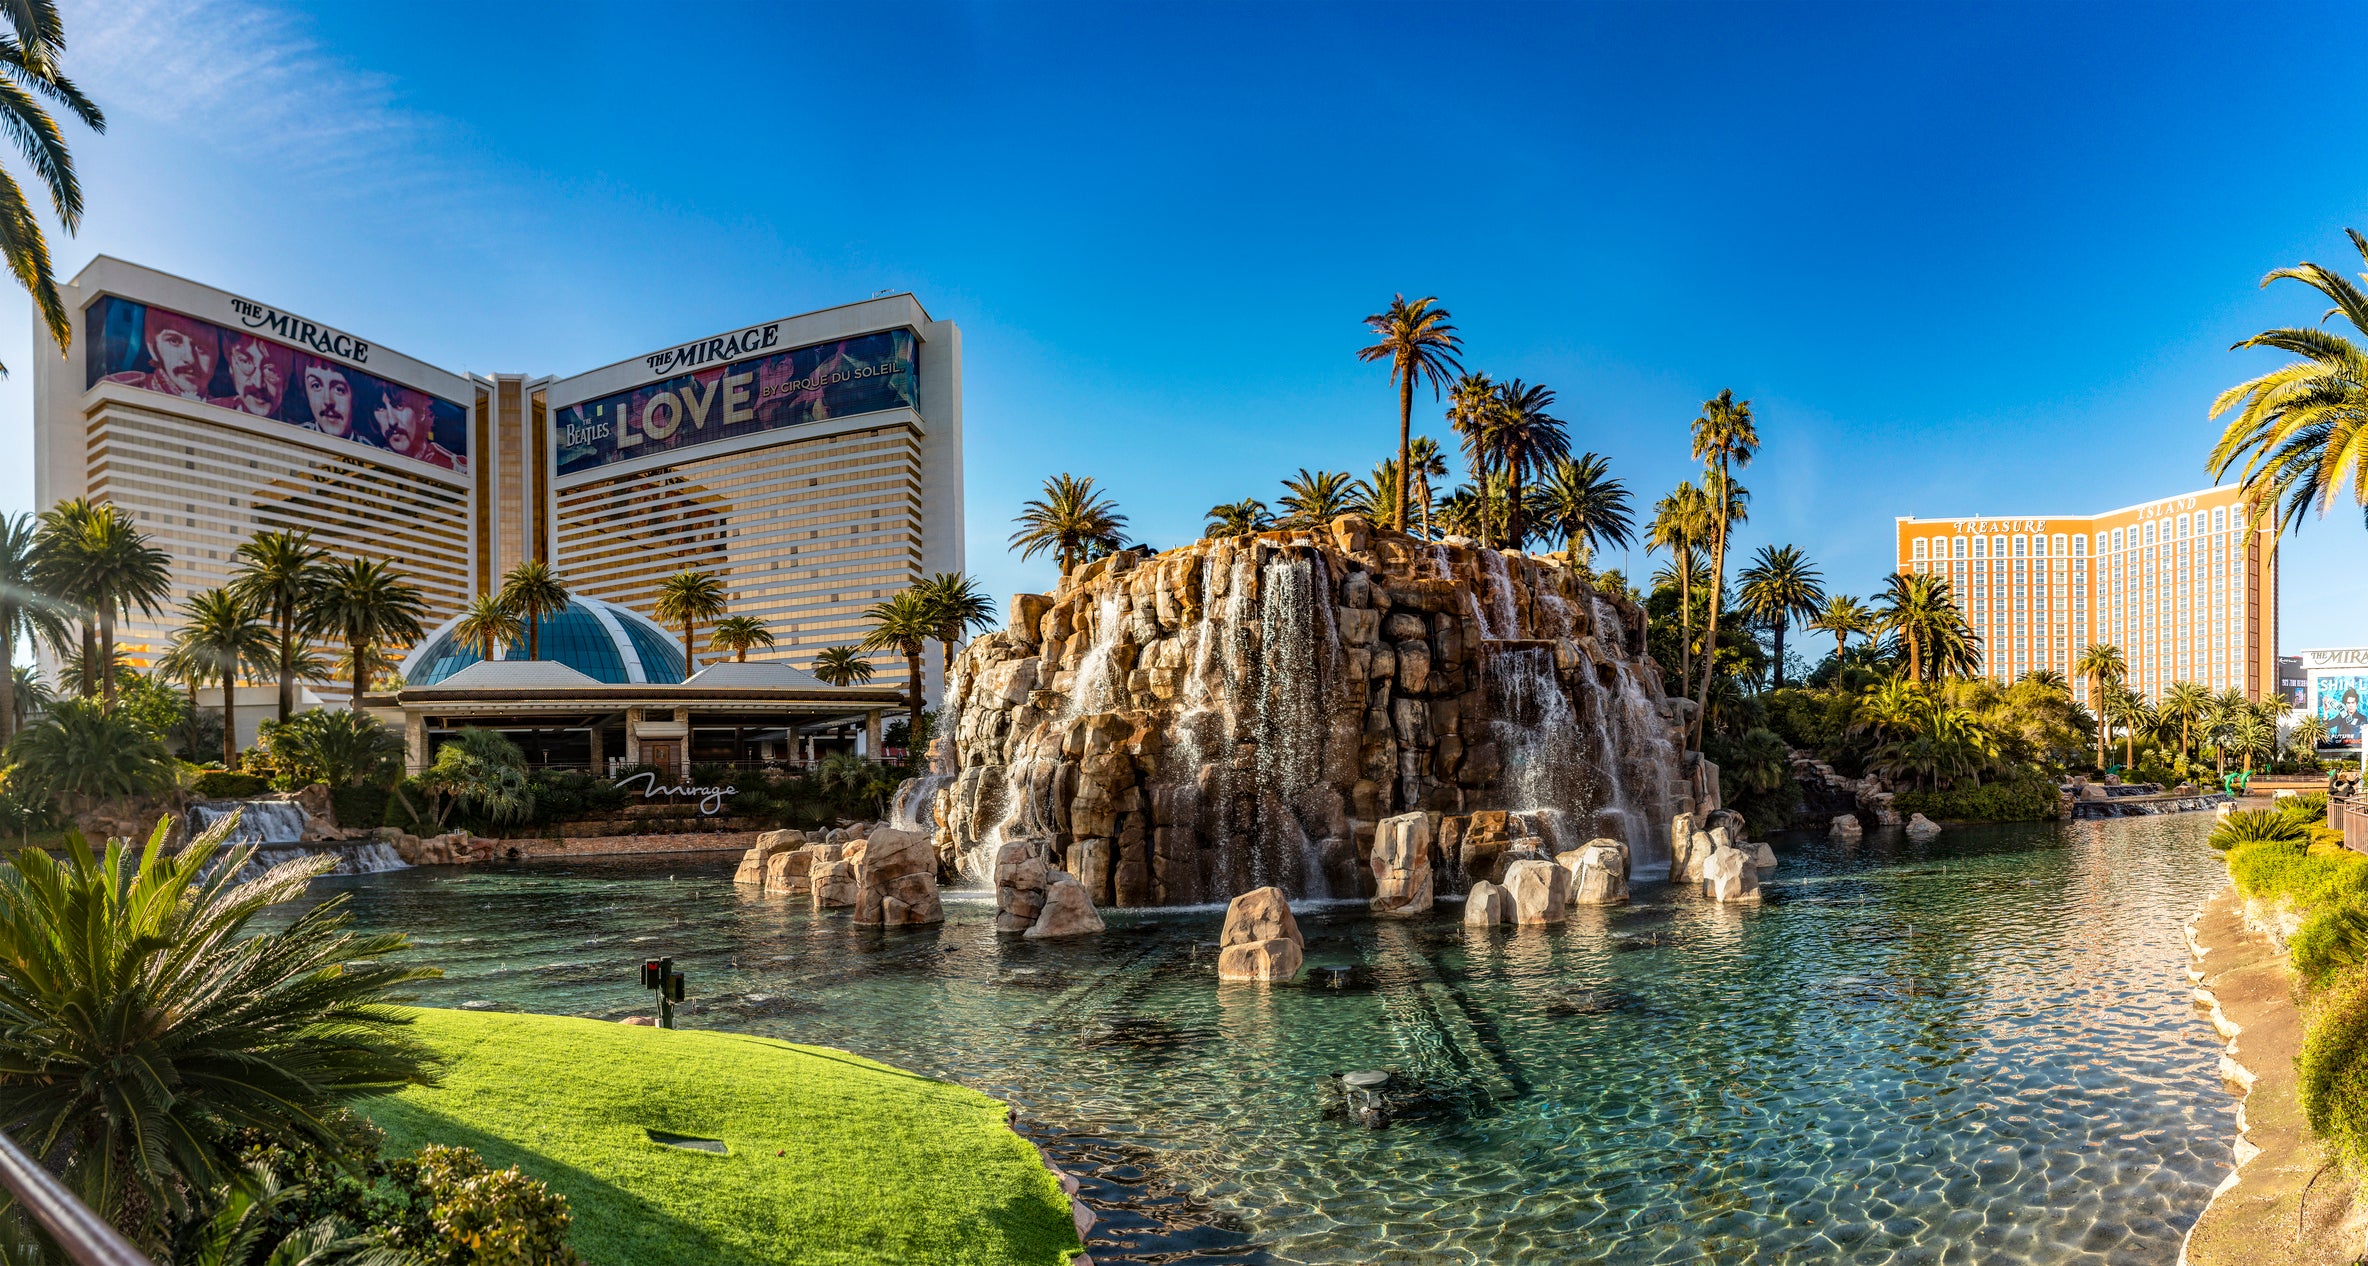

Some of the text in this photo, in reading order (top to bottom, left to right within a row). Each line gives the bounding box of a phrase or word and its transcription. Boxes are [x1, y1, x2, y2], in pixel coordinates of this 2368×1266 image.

[231, 299, 369, 364] THE MIRAGE
[646, 324, 779, 375] THE MIRAGE
[763, 362, 901, 397] BY CIRQUE DU SOLEIL
[582, 417, 593, 426] THE
[616, 371, 754, 450] LOVE
[566, 422, 610, 448] BEATLES
[1953, 497, 2197, 535] TREASURE ISLAND
[2311, 652, 2328, 660] THE
[2320, 679, 2355, 692] SHIN
